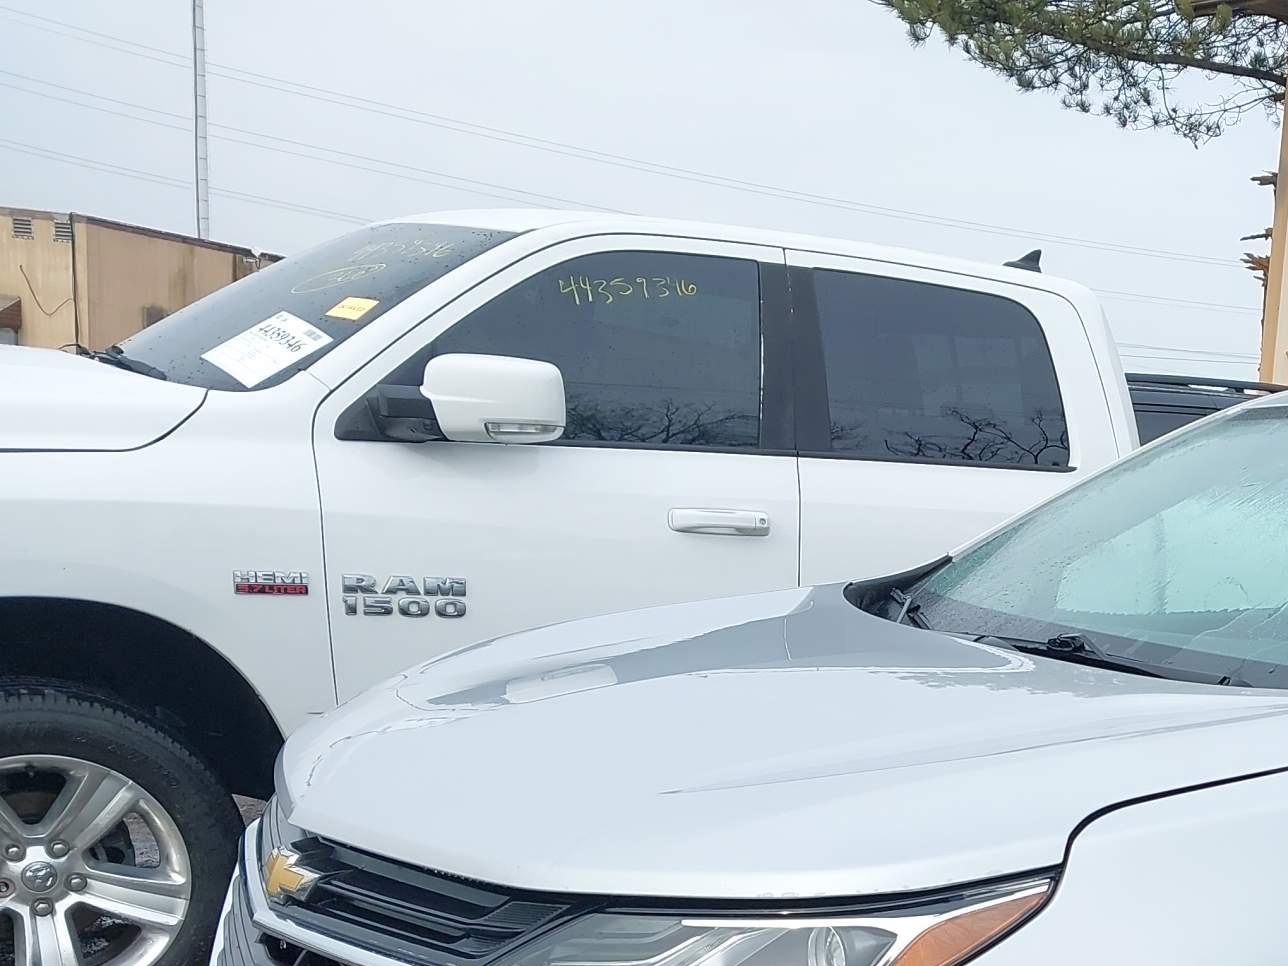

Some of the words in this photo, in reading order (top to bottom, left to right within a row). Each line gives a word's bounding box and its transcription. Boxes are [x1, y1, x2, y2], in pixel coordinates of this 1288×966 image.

[233, 570, 310, 584] HEMI
[342, 574, 467, 597] RAM
[238, 583, 263, 594] 5.7
[264, 584, 307, 594] LITER
[342, 596, 467, 619] 1500
